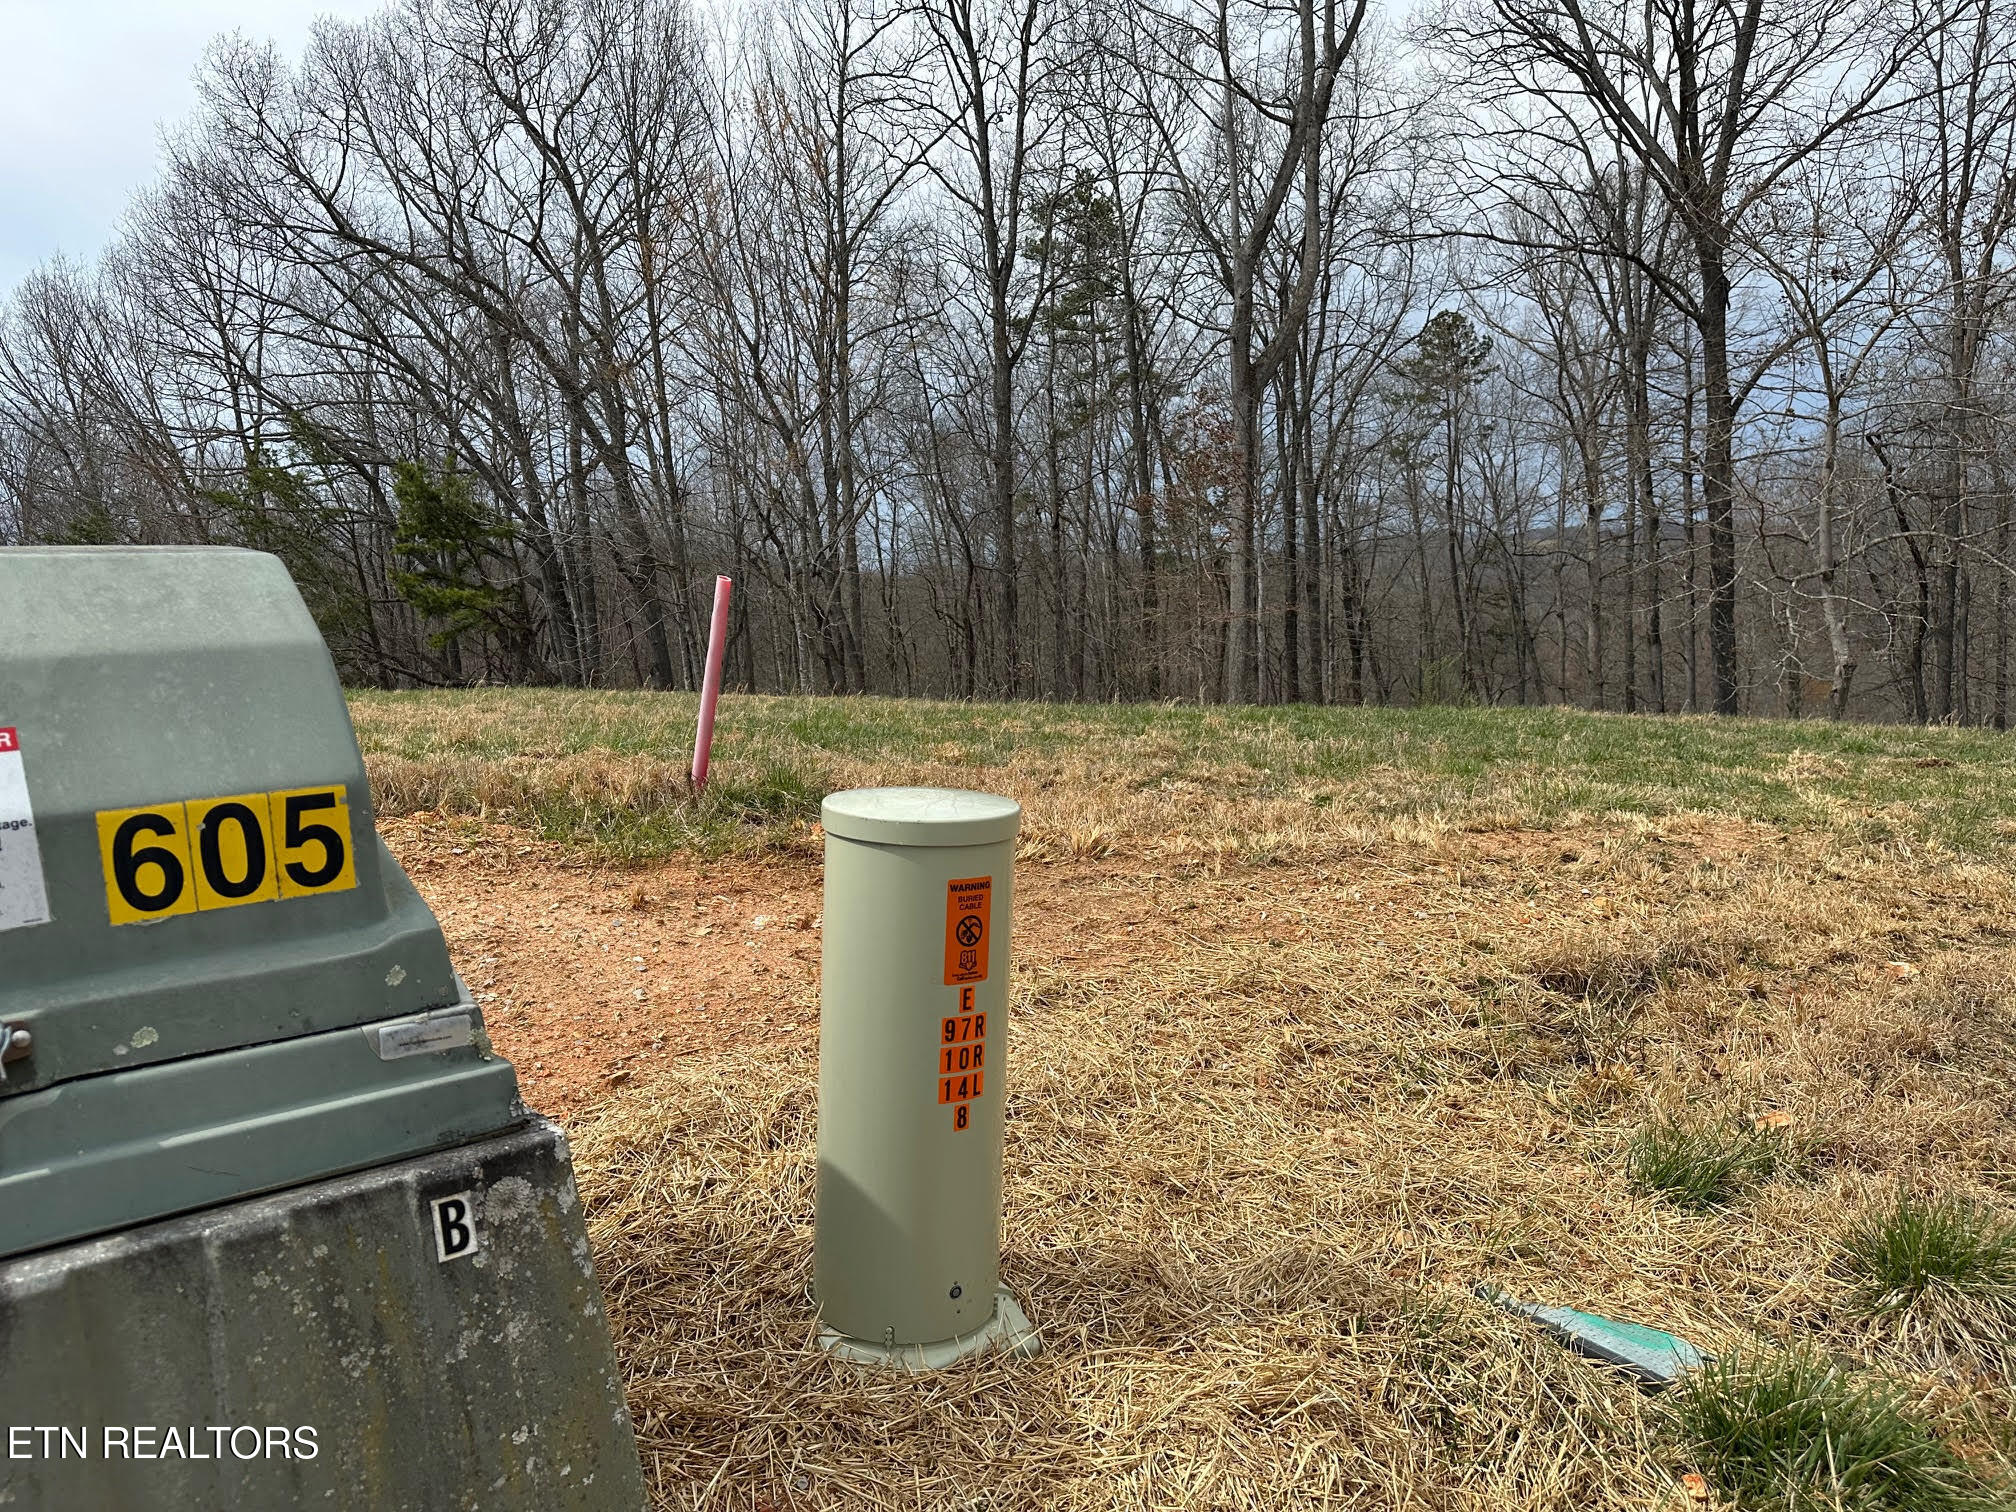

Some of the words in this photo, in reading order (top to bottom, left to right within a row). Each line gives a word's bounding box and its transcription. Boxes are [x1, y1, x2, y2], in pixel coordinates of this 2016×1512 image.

[0, 819, 33, 831] age.
[112, 791, 345, 912] 605
[949, 881, 991, 893] WARNING
[957, 894, 984, 903] BURIED
[959, 901, 982, 911] CABLE
[961, 950, 976, 964] 811
[962, 988, 972, 1011] E
[944, 1015, 985, 1042] 97R
[945, 1044, 983, 1071] 10R
[944, 1073, 981, 1101] 14L
[956, 1106, 967, 1129] 8
[438, 1199, 470, 1256] B
